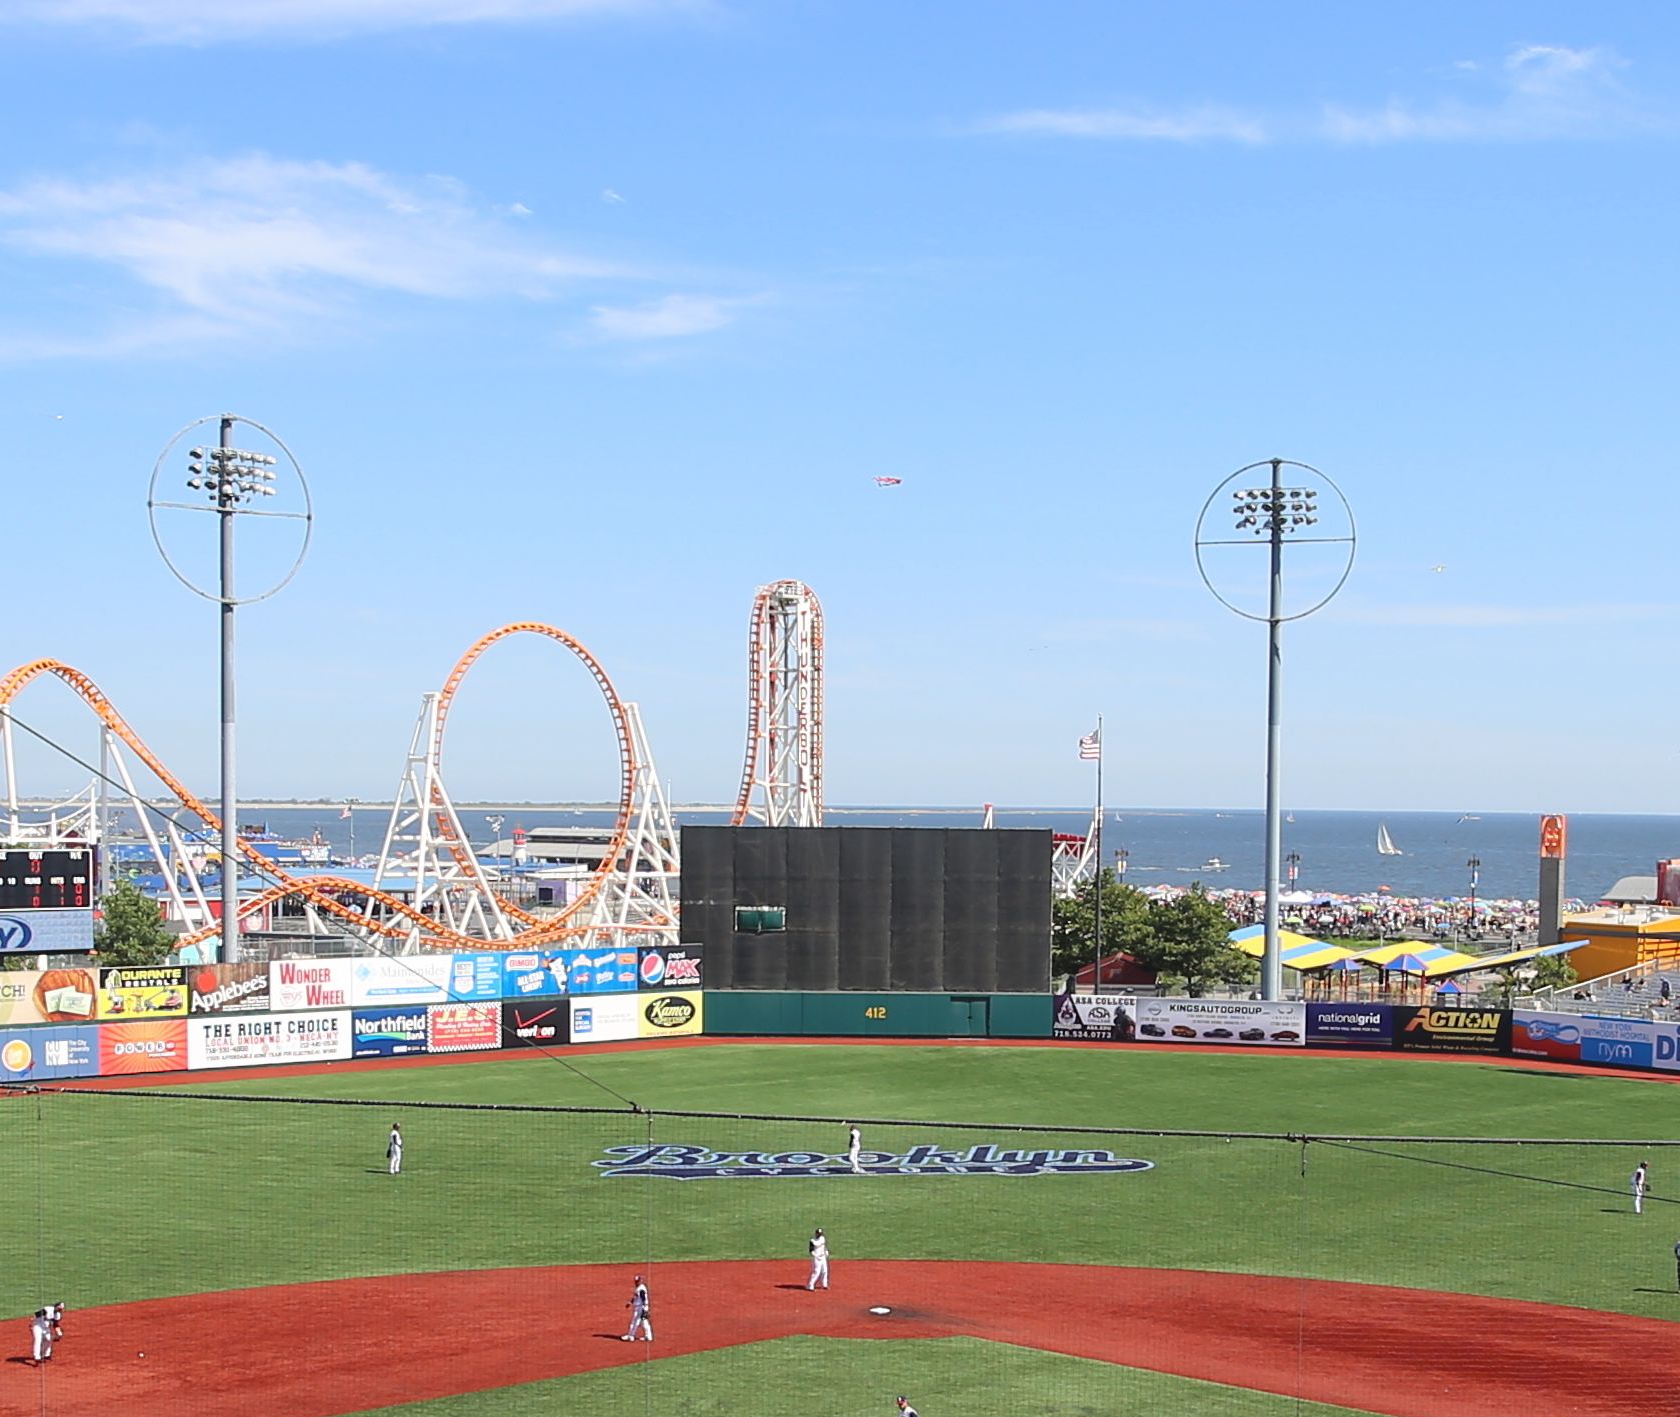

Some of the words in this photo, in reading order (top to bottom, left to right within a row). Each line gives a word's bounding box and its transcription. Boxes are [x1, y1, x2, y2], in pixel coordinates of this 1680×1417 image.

[28, 851, 43, 860] OUT
[667, 952, 686, 961] pepsi
[121, 968, 182, 981] DURANTE
[664, 959, 700, 979] MAX
[125, 979, 178, 988] RENTALS
[190, 975, 268, 1012] Applebee's
[651, 998, 692, 1017] Kamco
[1075, 997, 1092, 1005] ASA
[1095, 997, 1136, 1006] COLLEGE
[435, 1008, 493, 1023] J.E.S.
[865, 1006, 887, 1020] 412
[1088, 1006, 1110, 1018] ASA
[355, 1015, 426, 1034] Northfield
[1318, 1013, 1381, 1026] nationalgrid
[1405, 1007, 1501, 1035] ACTION
[203, 1024, 231, 1038] THE
[238, 1021, 282, 1036] RIGHT
[288, 1018, 338, 1033] CHOICE
[517, 1024, 556, 1038] verizon
[1583, 1028, 1618, 1038] METHODIST
[1615, 1023, 1632, 1031] YORK
[205, 1038, 233, 1047] LOCAL
[238, 1036, 265, 1045] UNION
[406, 1032, 425, 1041] Bank
[1432, 1033, 1475, 1042] Environmental
[1599, 1042, 1632, 1061] nym
[591, 1143, 1141, 1170] Brooklyn
